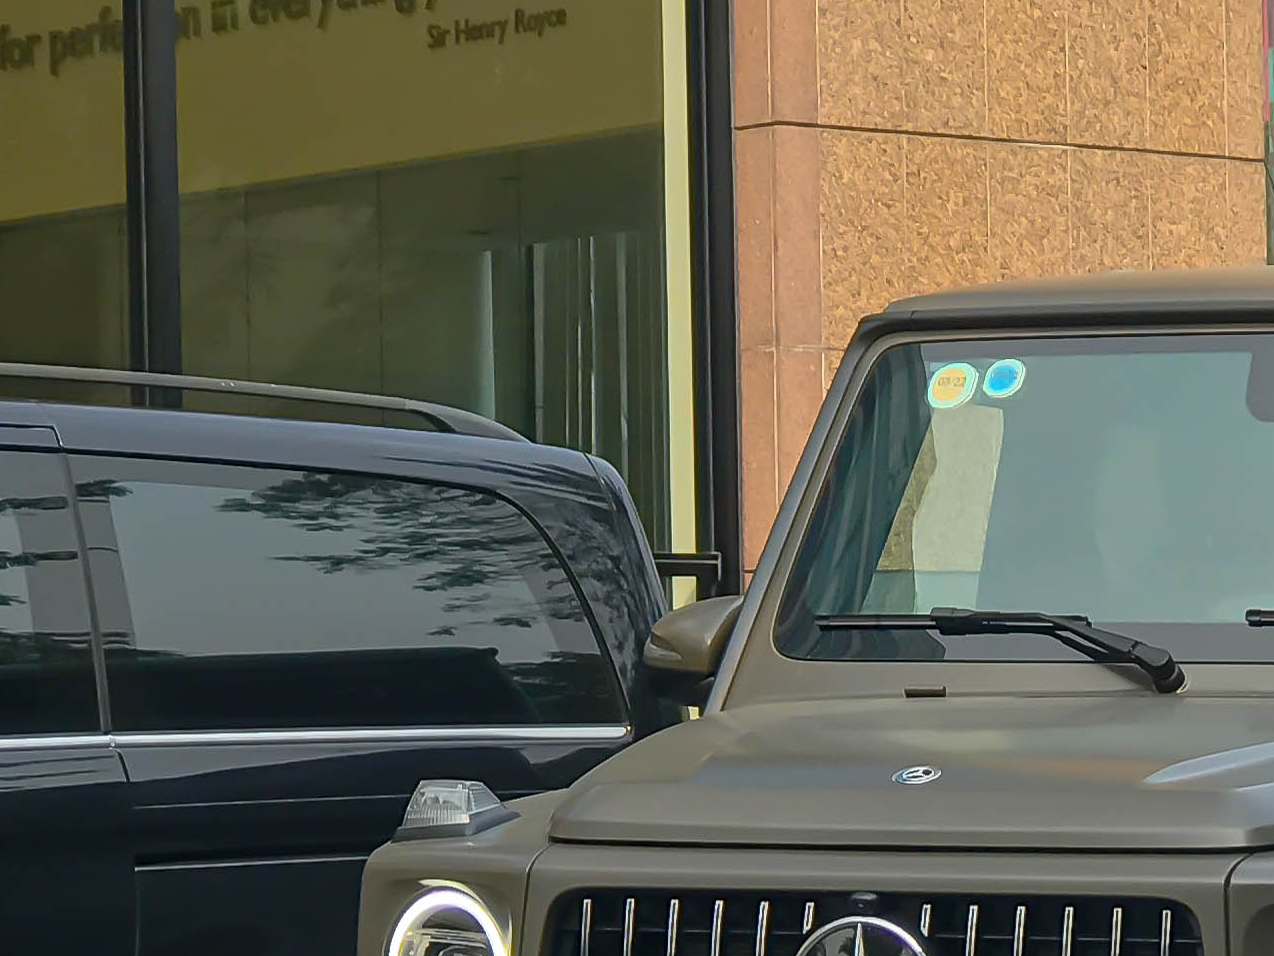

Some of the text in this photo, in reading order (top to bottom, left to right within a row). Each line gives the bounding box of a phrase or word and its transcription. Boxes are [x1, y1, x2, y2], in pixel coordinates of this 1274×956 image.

[427, 8, 567, 49] Sir Henry Royce
